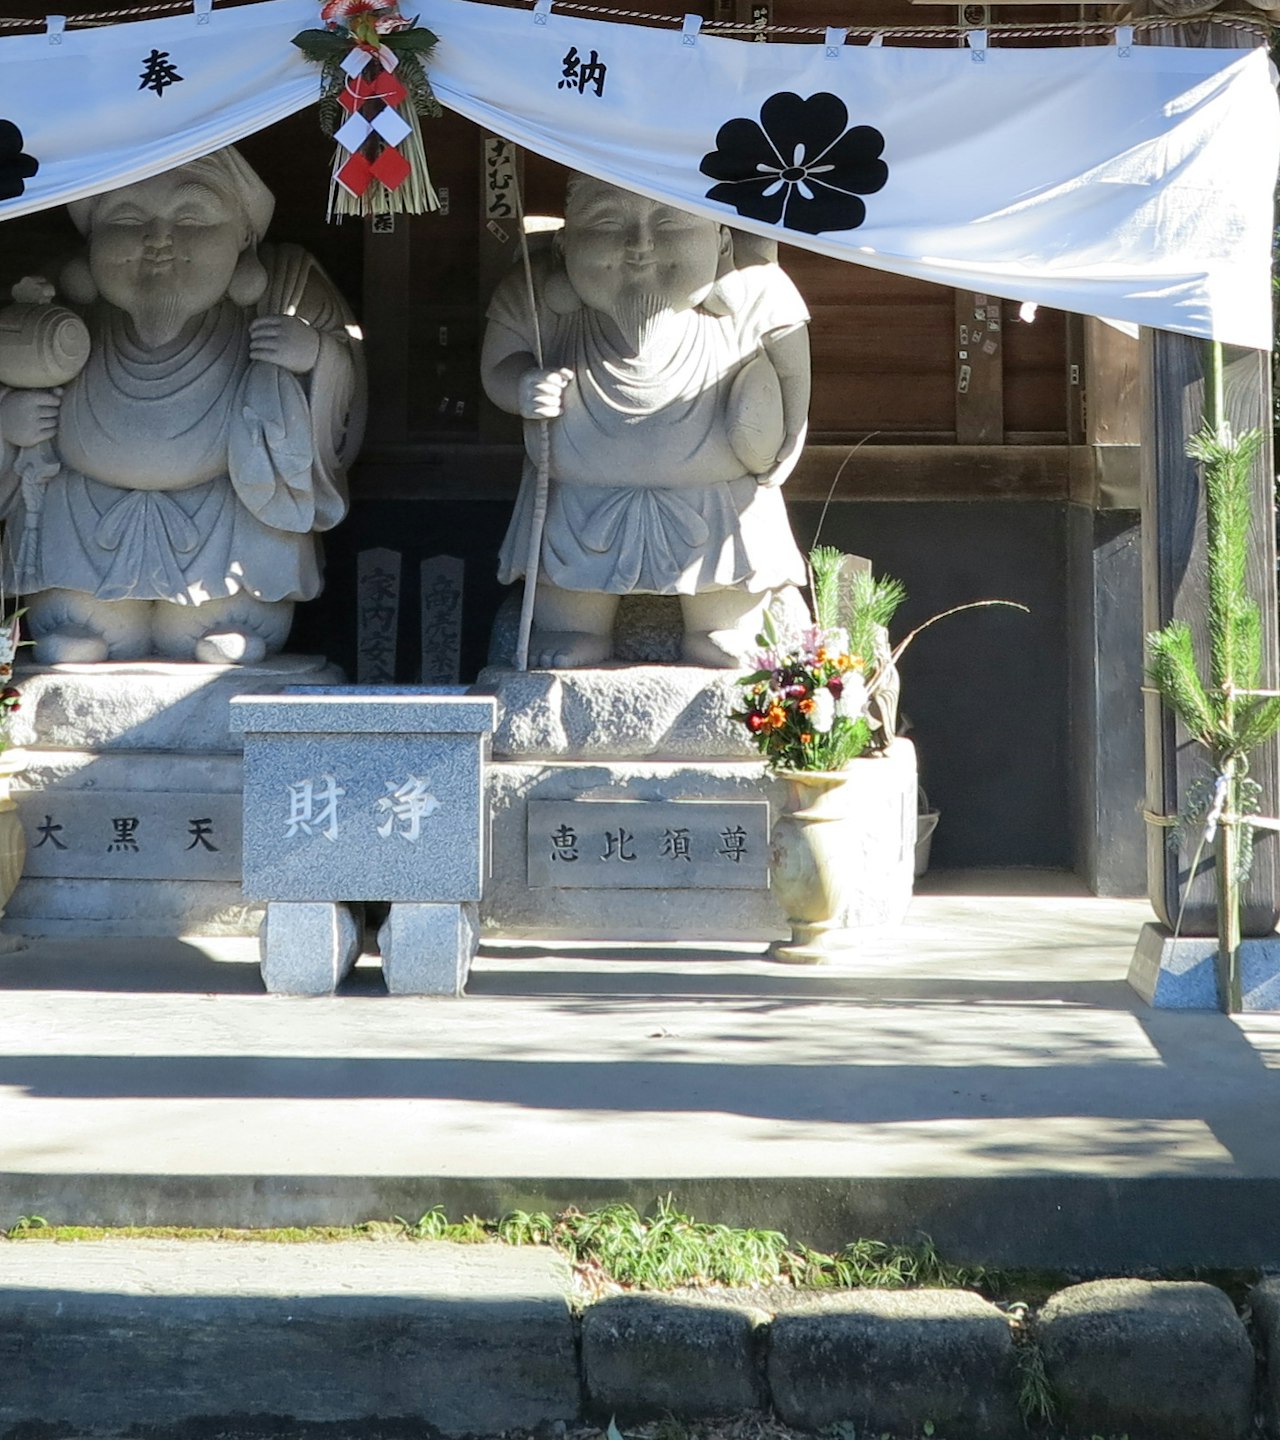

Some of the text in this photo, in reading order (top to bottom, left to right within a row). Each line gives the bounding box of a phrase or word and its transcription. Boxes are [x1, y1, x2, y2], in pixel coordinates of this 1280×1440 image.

[138, 47, 607, 98] 奉 納
[33, 815, 219, 854] 大黒天
[549, 824, 749, 864] 恵比須尊
